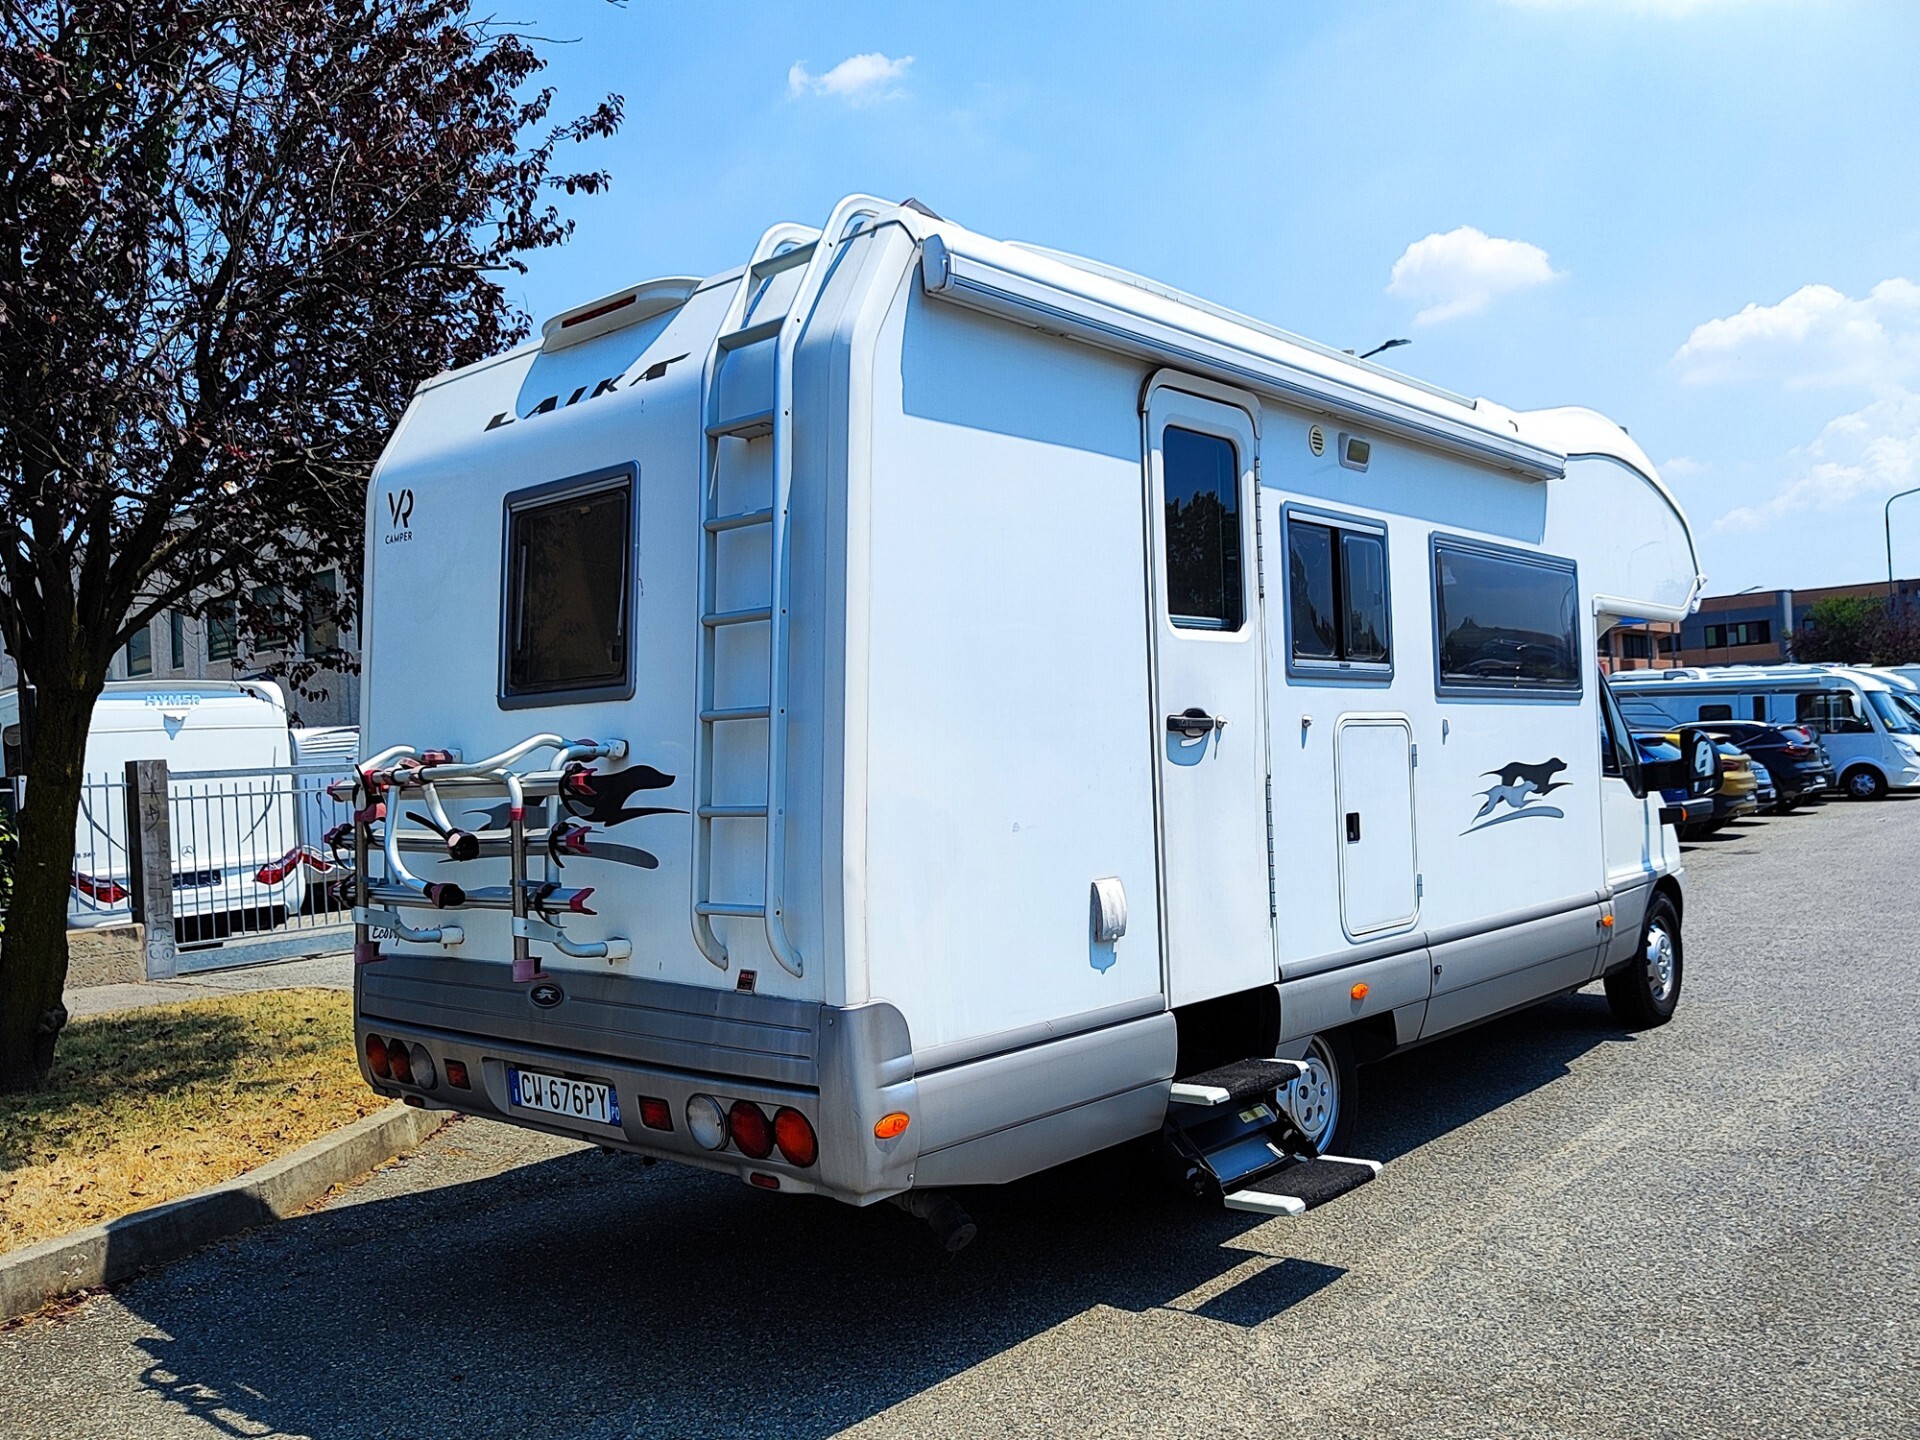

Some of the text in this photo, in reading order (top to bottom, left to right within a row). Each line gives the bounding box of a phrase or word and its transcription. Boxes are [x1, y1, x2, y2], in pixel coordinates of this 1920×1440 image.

[484, 352, 691, 432] LAIKA
[385, 531, 413, 545] CAMPER
[145, 694, 201, 706] HYMER
[549, 1079, 606, 1119] 676PY
